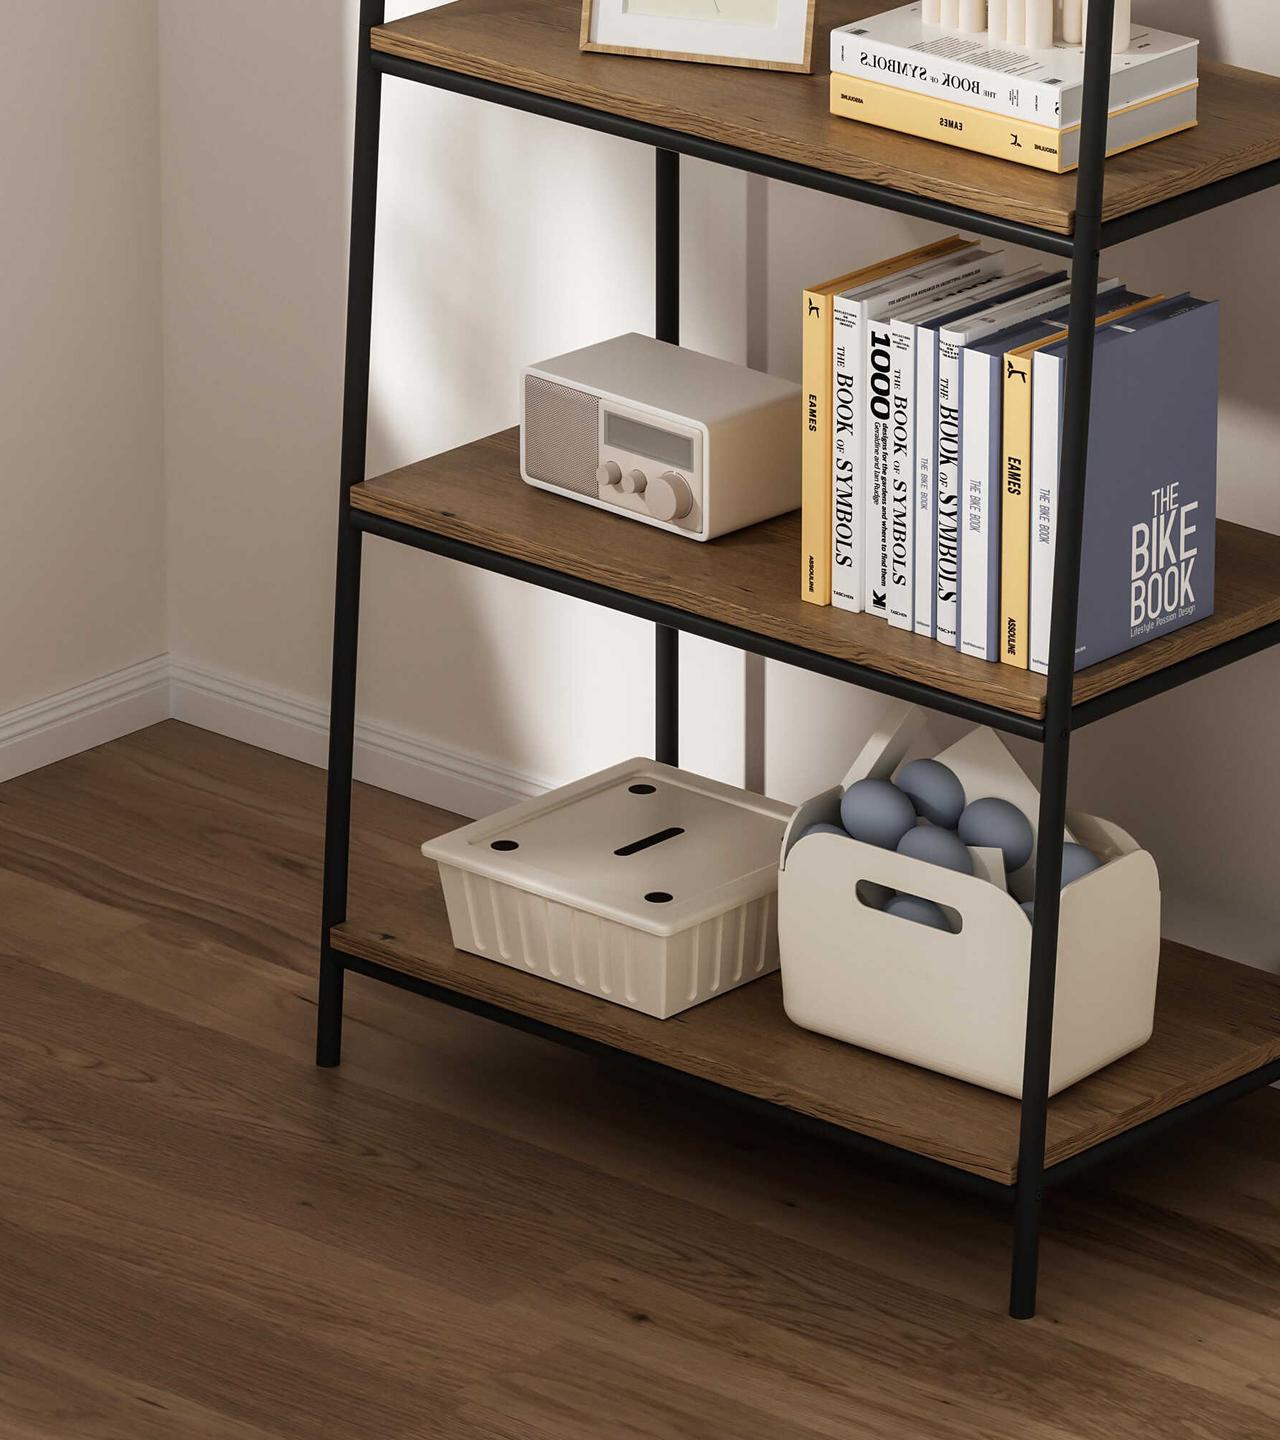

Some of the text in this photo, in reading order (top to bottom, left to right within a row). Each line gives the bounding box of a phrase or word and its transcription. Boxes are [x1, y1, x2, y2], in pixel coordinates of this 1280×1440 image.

[870, 331, 891, 421] 1000
[940, 378, 949, 400] THE
[808, 394, 817, 432] EAMES
[835, 346, 854, 567] THE BOOK OF SYMBOLS
[1007, 456, 1022, 496] EAMES
[880, 475, 888, 504] gardens
[892, 369, 908, 587] THE BOOK OF SYMBOLS
[921, 458, 929, 510] THE BIKE BOOK
[939, 471, 948, 488] OF
[970, 479, 982, 534] THE BIKE BOOK
[1039, 488, 1051, 544] THE BIKE BOOK
[1151, 481, 1180, 516] THE
[1131, 500, 1199, 581] BIKE
[833, 590, 854, 600] TASCHEN
[1130, 557, 1196, 628] BOOK
[890, 609, 908, 618] TASCHEN
[1130, 604, 1196, 638] Lifestyle Passion Design
[1007, 617, 1017, 656] ASSOULINE
